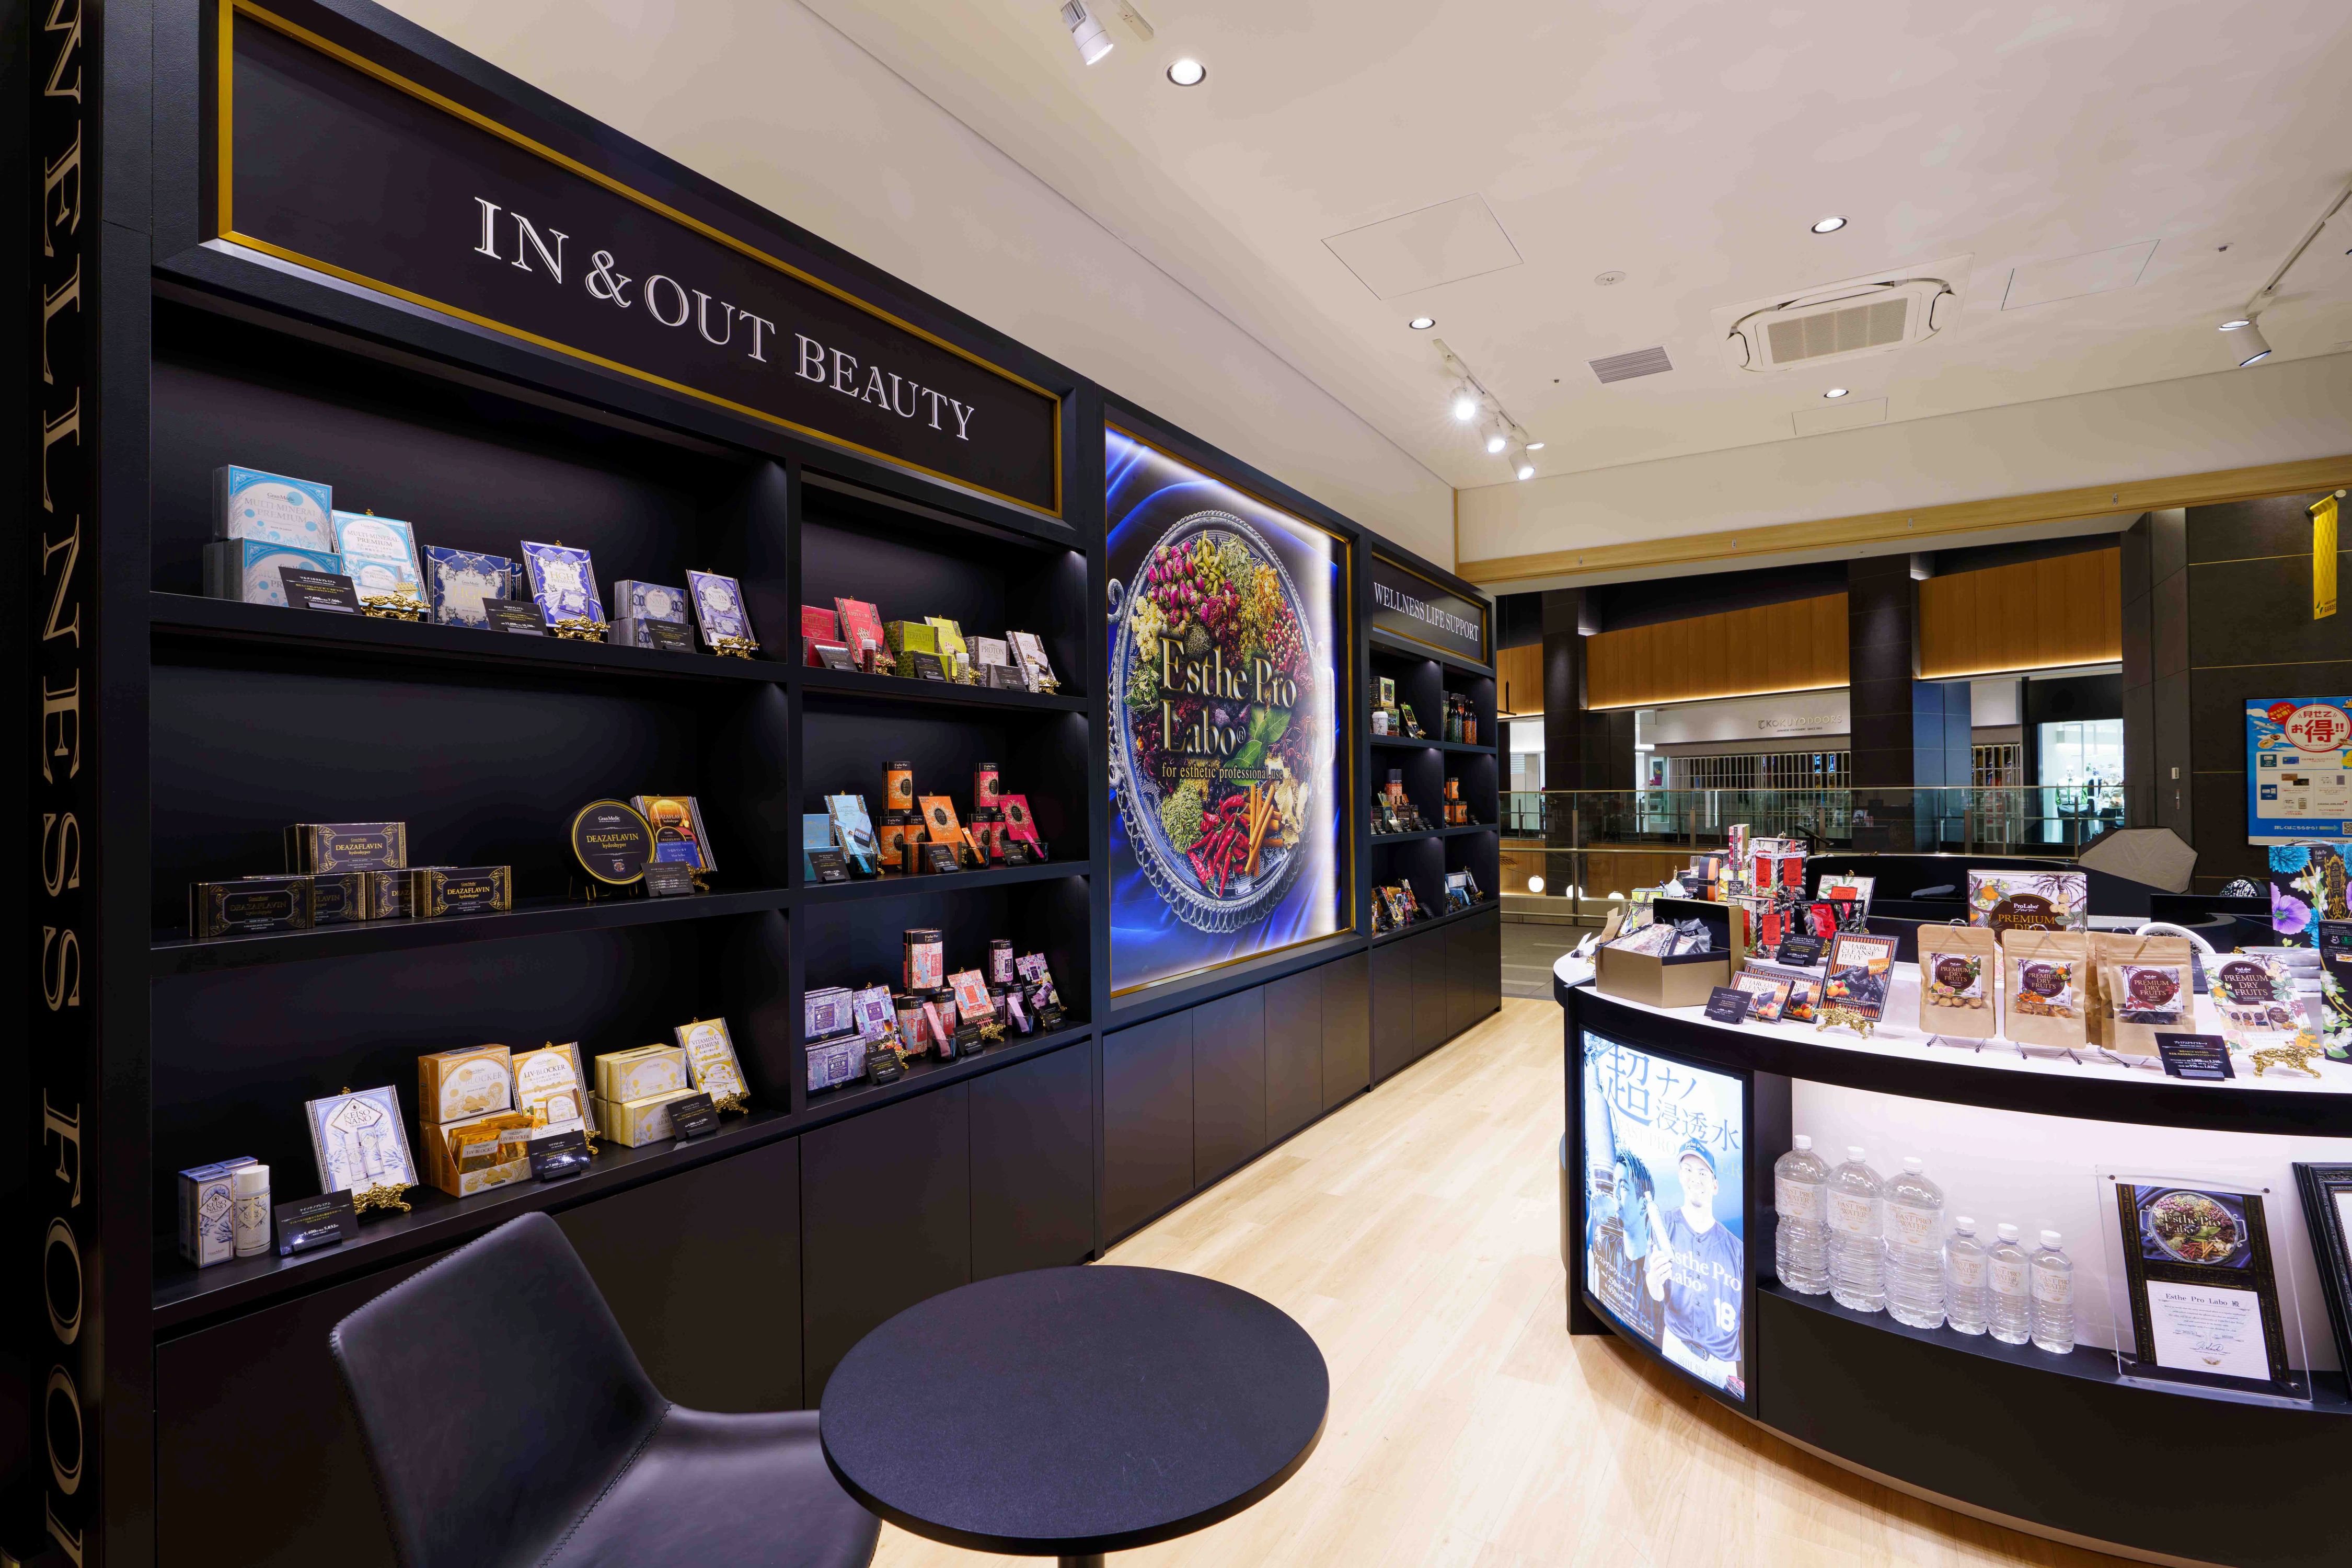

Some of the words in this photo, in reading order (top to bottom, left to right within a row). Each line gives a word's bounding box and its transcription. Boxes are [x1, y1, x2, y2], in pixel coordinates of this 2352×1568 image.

[474, 197, 569, 284] IN
[585, 250, 632, 308] &
[644, 274, 776, 363] OUT
[794, 333, 975, 441] BEAUTY
[257, 508, 307, 523] PREMIUM
[550, 571, 574, 581] HGH
[1374, 582, 1424, 621] WELLNESS
[1426, 604, 1445, 628] LIFE
[1446, 613, 1479, 642] SUPPORT
[981, 645, 1005, 654] PROTON
[1159, 637, 1248, 701] Esthe
[1253, 656, 1297, 709] Pro
[1162, 765, 1177, 777] for
[1180, 766, 1216, 778] esthetic
[1219, 765, 1269, 782] professional
[1270, 768, 1283, 779] use
[586, 833, 639, 843] DEAZAFLAVIN
[336, 843, 383, 851] DEAZAFLAVIN
[447, 886, 490, 895] DEAZAFLAVIN
[315, 894, 340, 903] FLAVIN
[230, 901, 287, 912] DEAZAFLAVIN
[1998, 914, 2057, 925] PREMIUM
[1841, 948, 1876, 957] CLEANSE
[2224, 974, 2270, 983] PREMIUM
[1740, 984, 1769, 993] CLEANSE
[691, 1037, 714, 1045] VITAMIN
[696, 1041, 720, 1050] PREMIUM
[524, 1064, 566, 1078] LIV-BLOCKER
[1607, 1043, 1652, 1126] 超
[1655, 1067, 1697, 1100] ナノ
[343, 1110, 370, 1120] KEISO
[345, 1115, 372, 1126] NANO
[1655, 1098, 1742, 1152] 浸透水
[1786, 1193, 1810, 1204] WATER
[206, 1200, 226, 1208] KEISO
[206, 1204, 226, 1212] NANO
[1837, 1201, 1853, 1209] FAST
[1841, 1207, 1866, 1218] WATER
[1896, 1212, 1912, 1221] FAST
[1916, 1216, 1932, 1224] PRO
[2164, 1213, 2198, 1224] Esthe
[2200, 1216, 2221, 1227] Pro
[1899, 1220, 1928, 1230] WATER
[1952, 1258, 1967, 1267] FAST
[1674, 1251, 1709, 1276] sthe
[1712, 1261, 1742, 1292] Pro
[1956, 1265, 1978, 1274] WATER
[1994, 1272, 2017, 1282] WATER
[2040, 1275, 2055, 1284] FAST
[2044, 1281, 2068, 1290] WATER
[1714, 1297, 1736, 1332] 18
